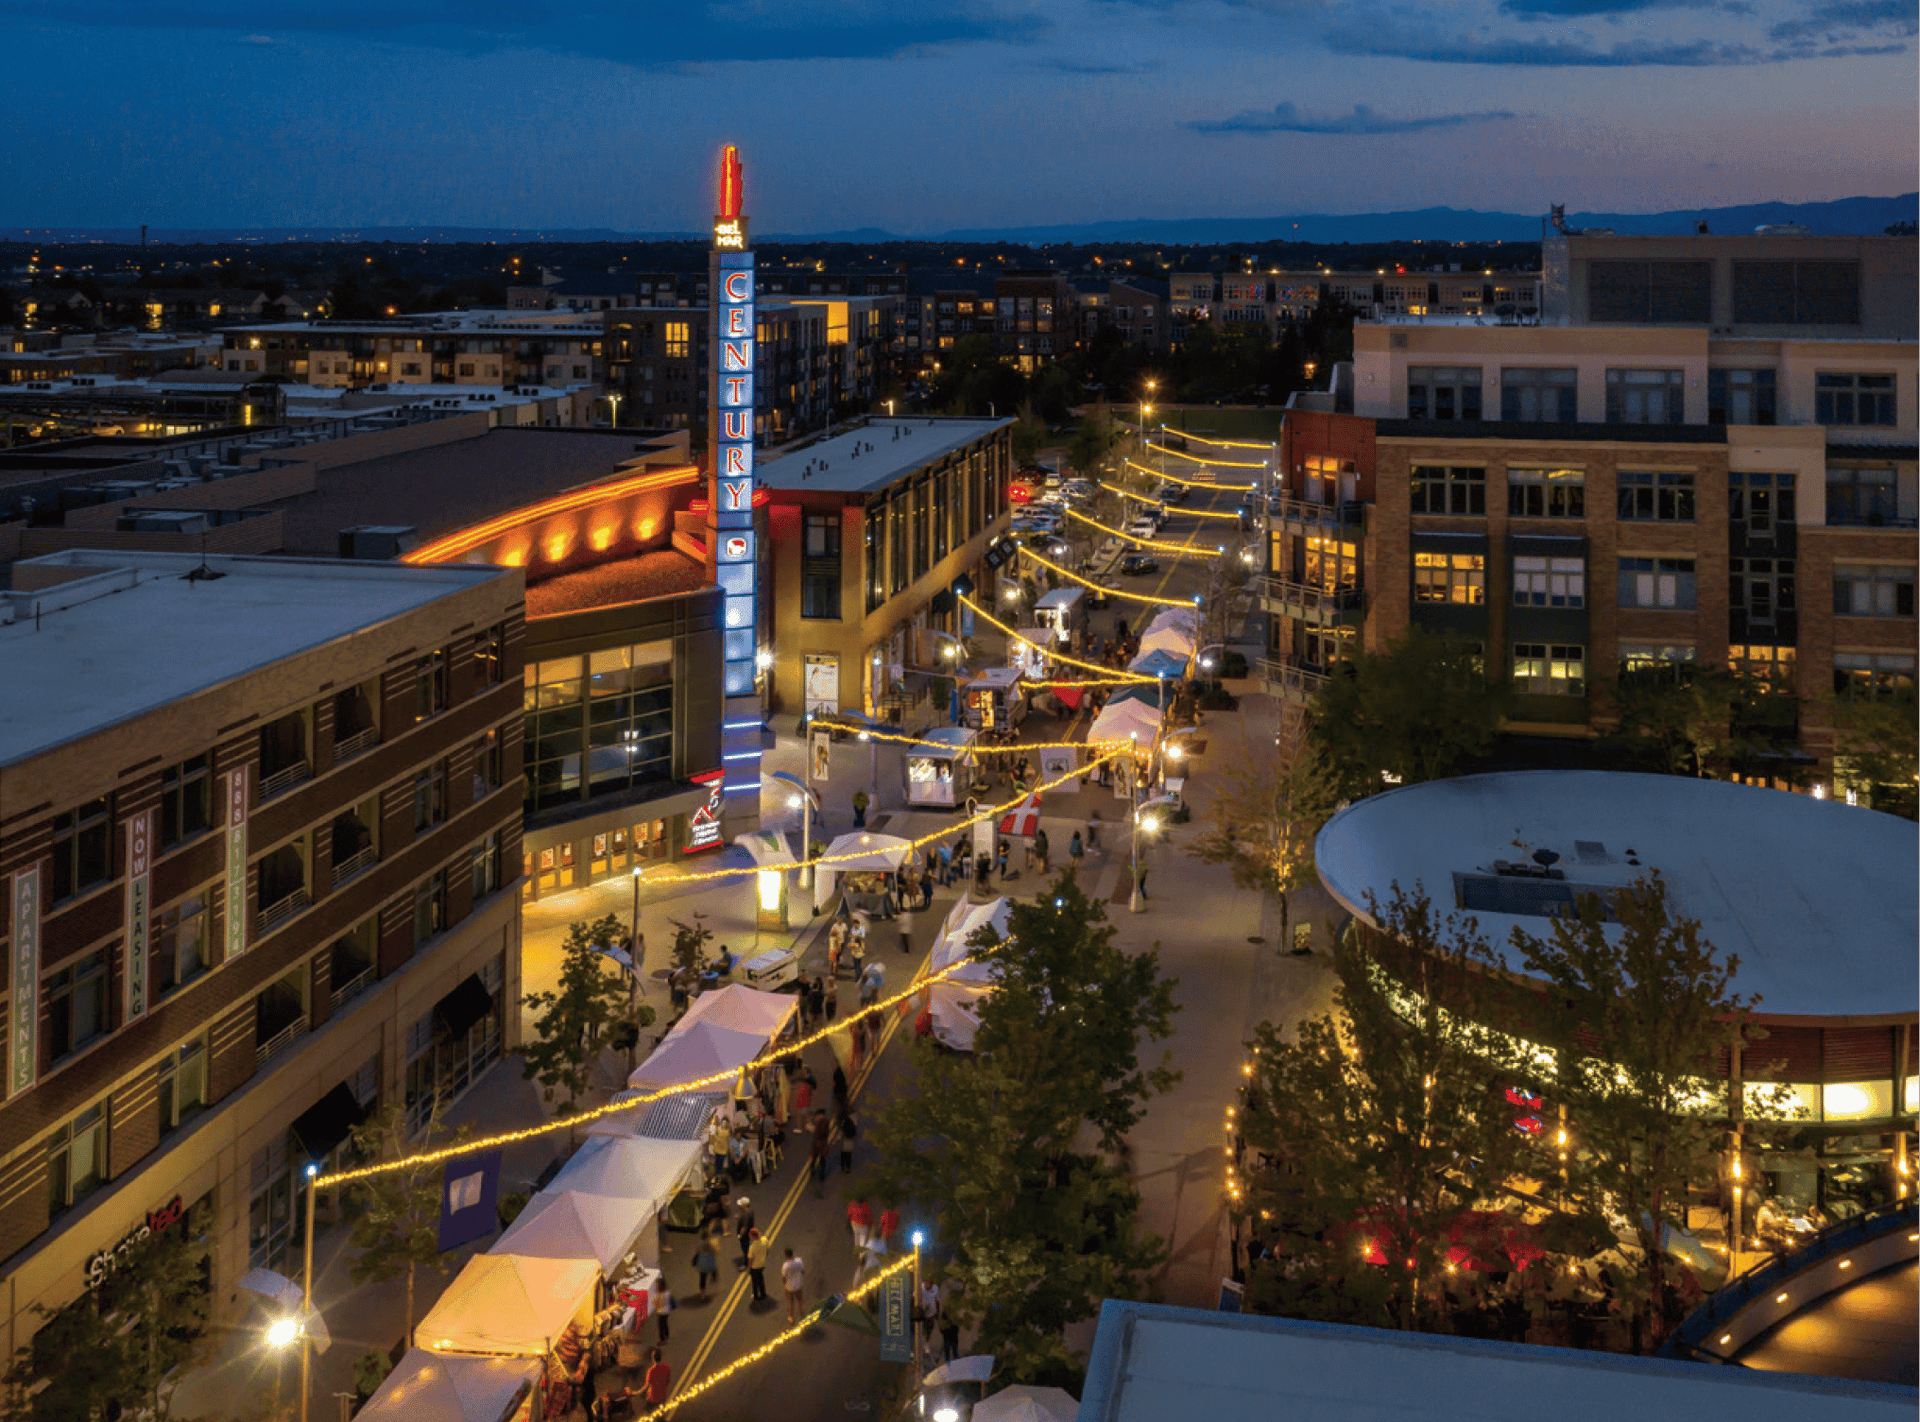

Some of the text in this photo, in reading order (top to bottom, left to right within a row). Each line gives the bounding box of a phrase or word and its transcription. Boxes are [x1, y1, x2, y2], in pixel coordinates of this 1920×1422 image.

[725, 272, 749, 508] CENTURY
[18, 882, 32, 1086] APARTMENTS
[132, 818, 146, 1016] NOW LEASING
